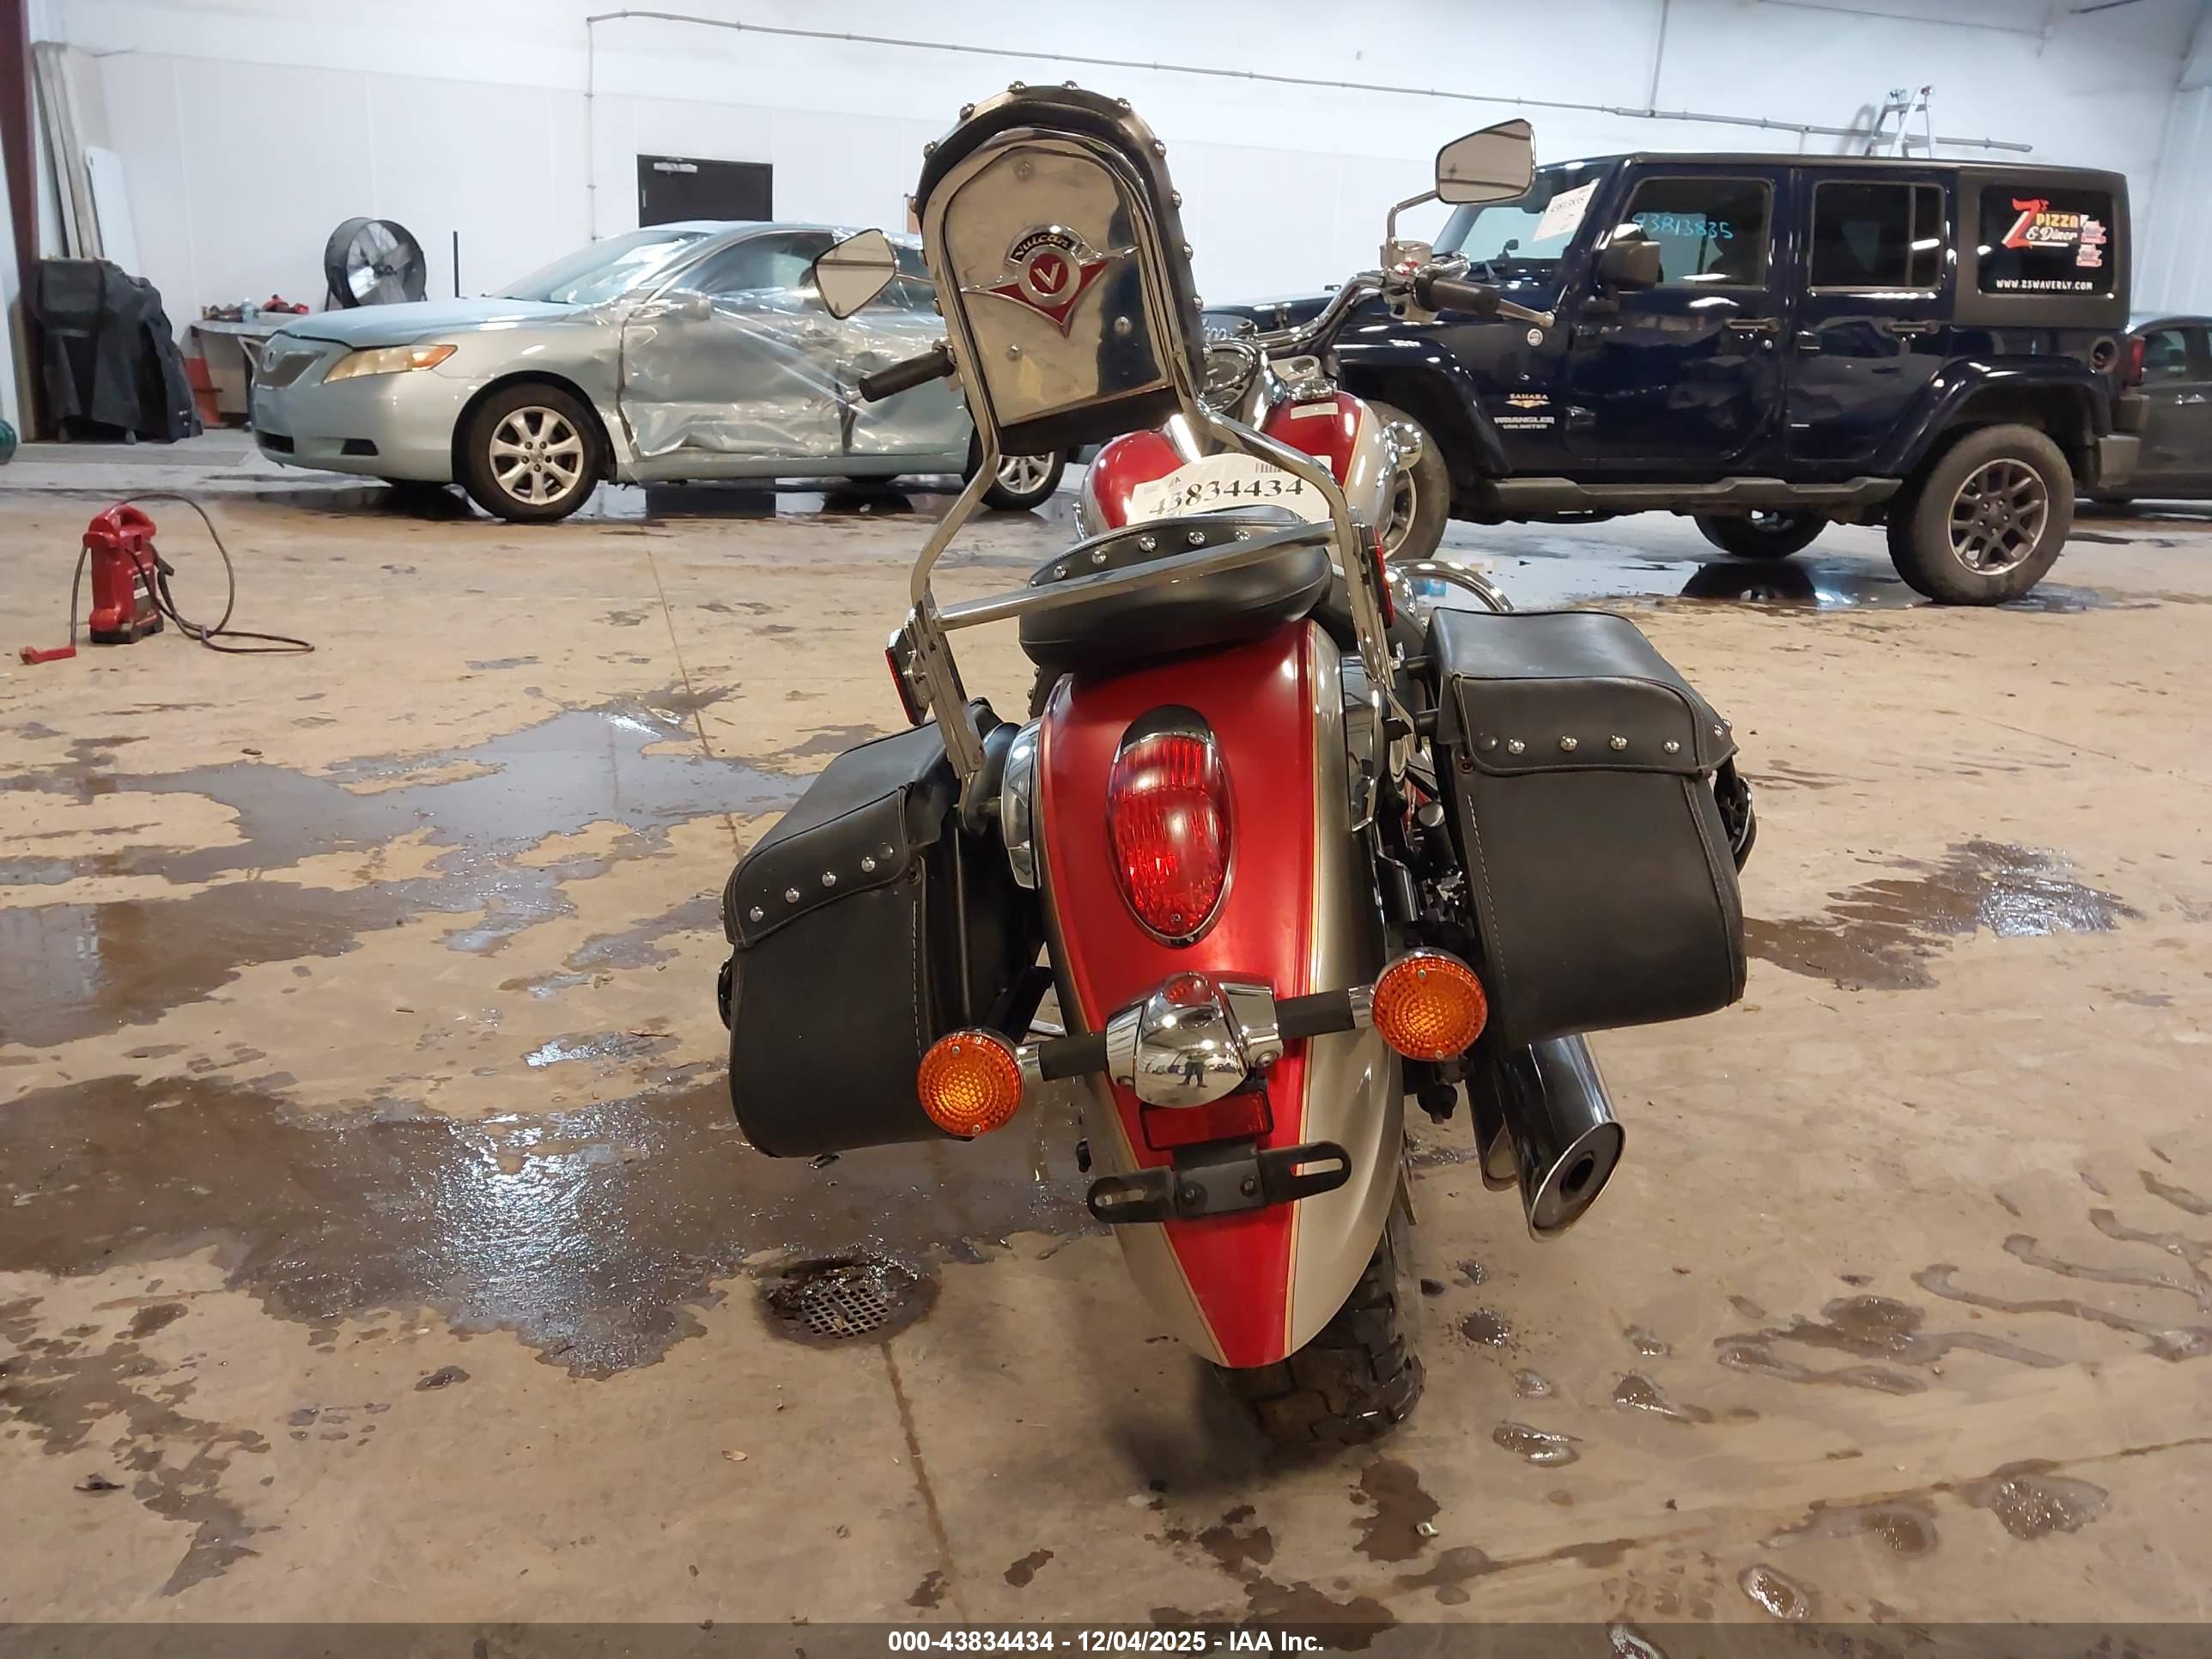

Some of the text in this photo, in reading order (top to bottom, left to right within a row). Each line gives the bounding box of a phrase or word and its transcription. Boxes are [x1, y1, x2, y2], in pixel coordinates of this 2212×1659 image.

[2036, 212, 2079, 228] PIZZA
[2039, 226, 2078, 241] Diner
[1996, 279, 2094, 290] WWW.ZSWAVERLY.COM
[1149, 478, 1304, 515] 43834434
